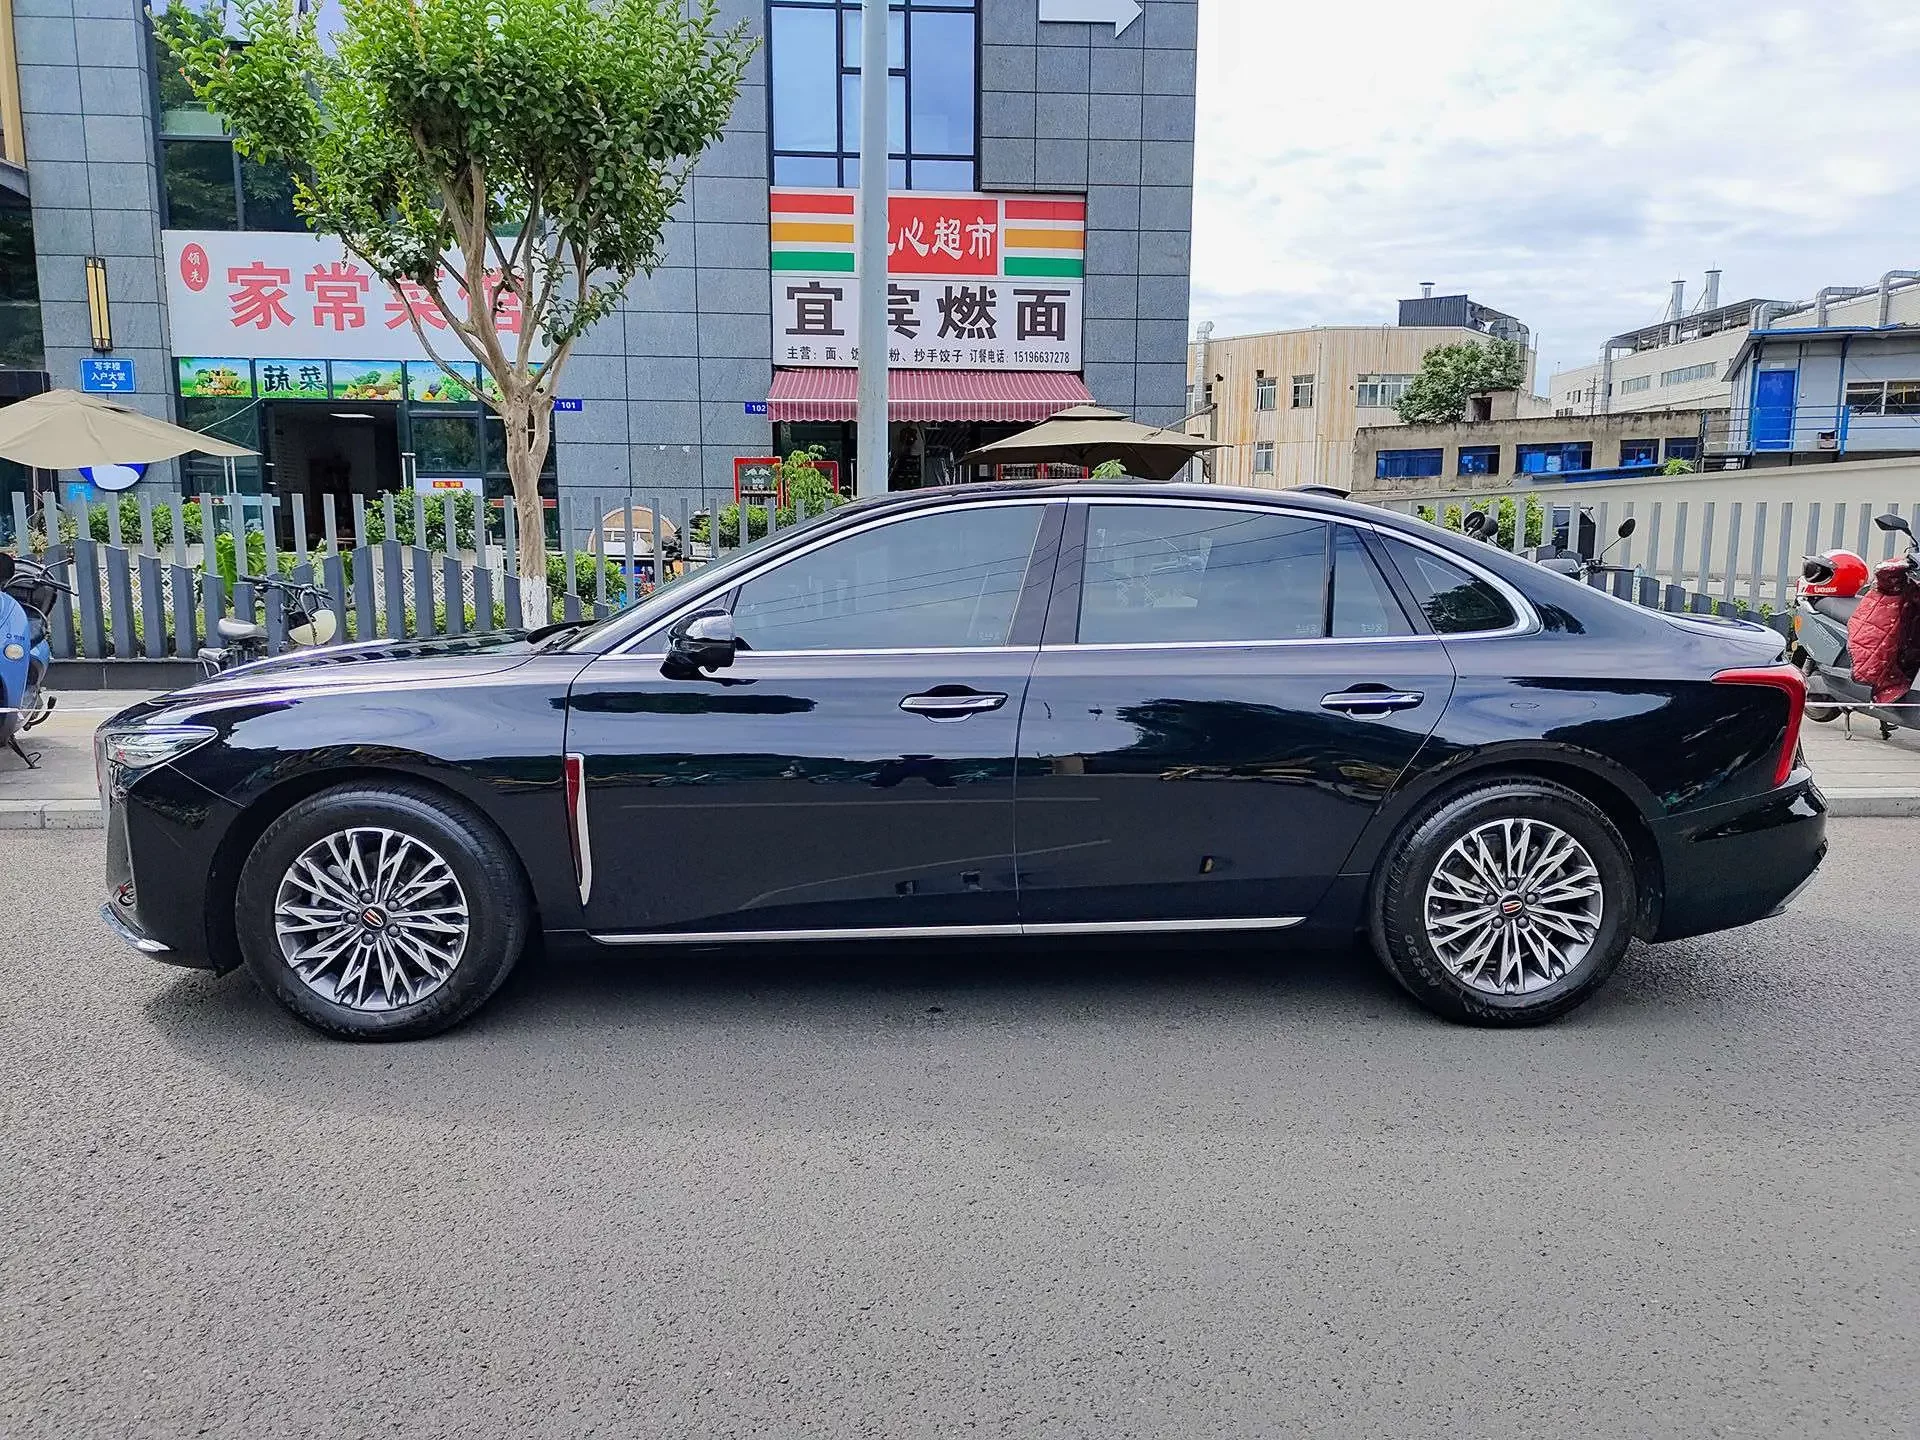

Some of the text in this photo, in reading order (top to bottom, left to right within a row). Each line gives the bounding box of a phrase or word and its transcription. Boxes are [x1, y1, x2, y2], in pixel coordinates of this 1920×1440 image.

[888, 216, 997, 260] 心超市
[91, 372, 126, 381] 入户大堂
[263, 365, 326, 392] 蔬菜
[751, 404, 766, 412] 102
